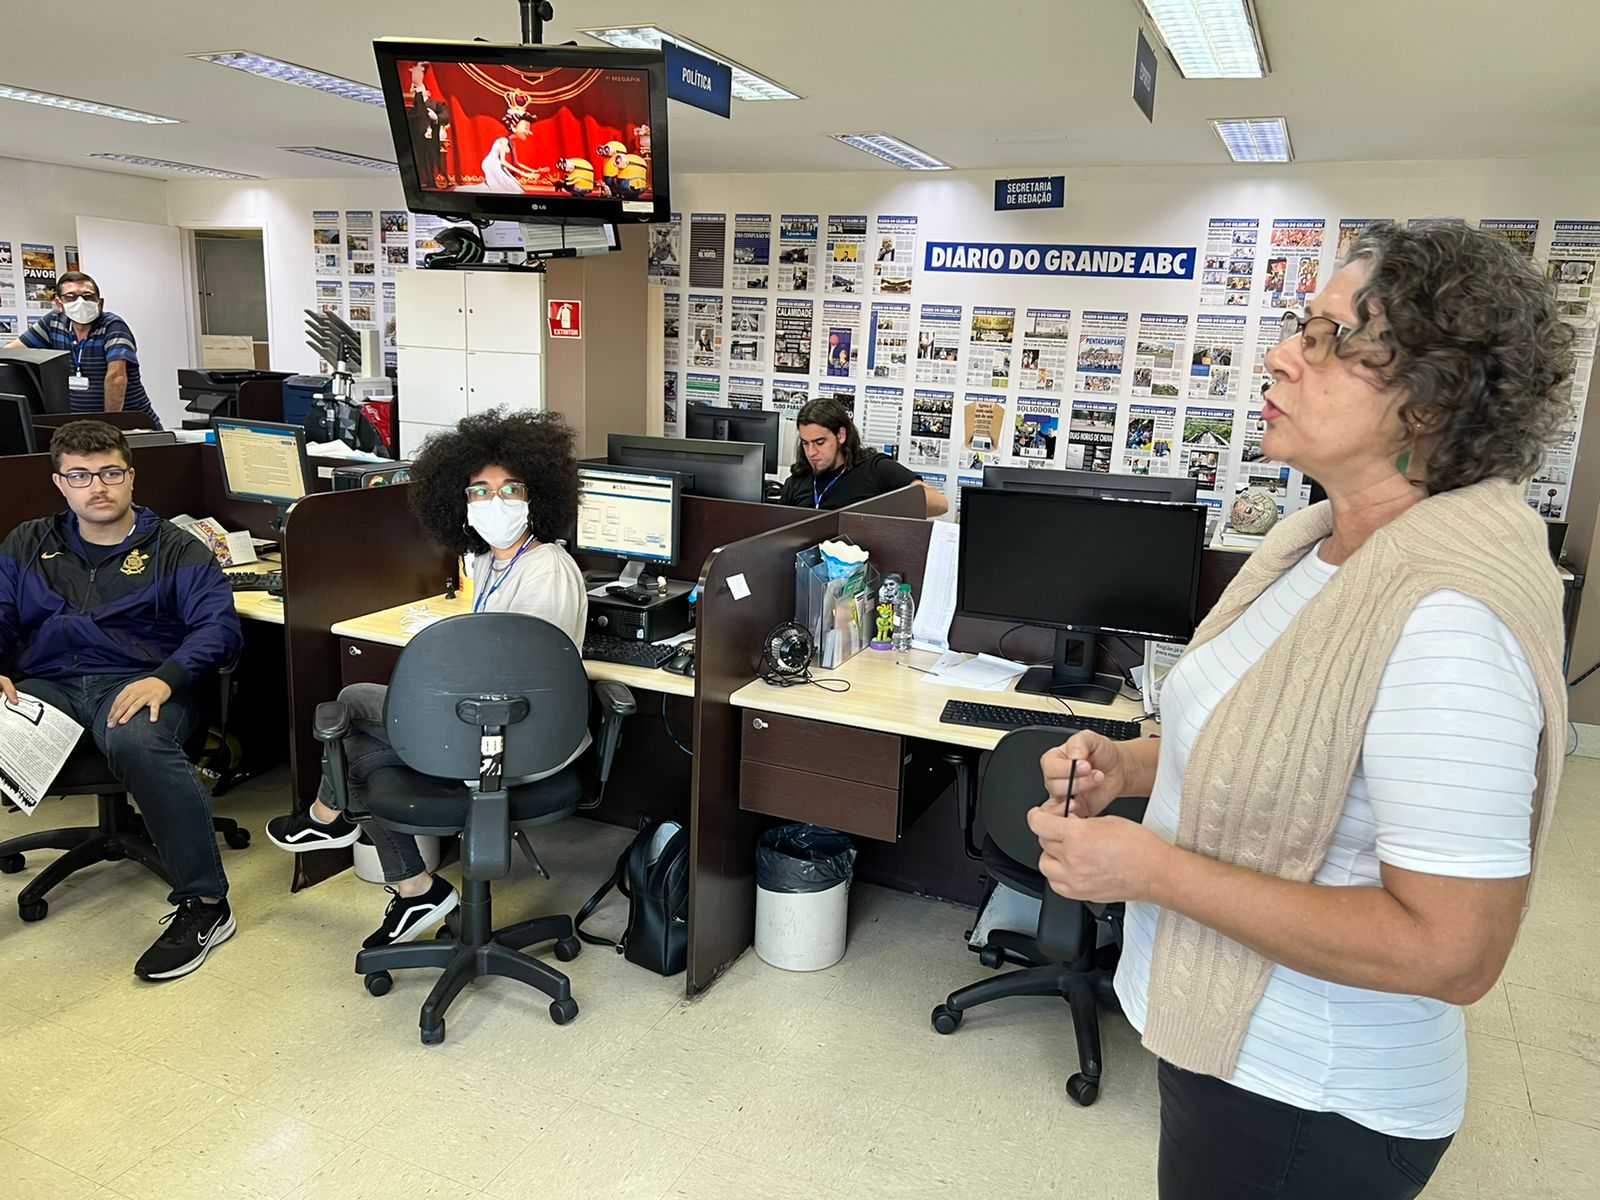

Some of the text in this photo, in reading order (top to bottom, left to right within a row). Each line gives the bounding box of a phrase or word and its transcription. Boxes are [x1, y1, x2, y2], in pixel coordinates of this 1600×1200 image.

[682, 67, 711, 91] POLÍTICA
[1007, 181, 1052, 193] SECRETARIA
[1006, 191, 1052, 205] DE REDAÇÃO
[931, 245, 1188, 275] DIÁRIO DO GRANDE ABC
[24, 269, 56, 279] PAVOR
[777, 307, 812, 317] CALAMIDADE
[553, 328, 579, 336] EXTINTOR
[1016, 405, 1059, 414] BOLSODORIA
[1069, 431, 1080, 440] DUAS
[1080, 432, 1093, 441] HORAS
